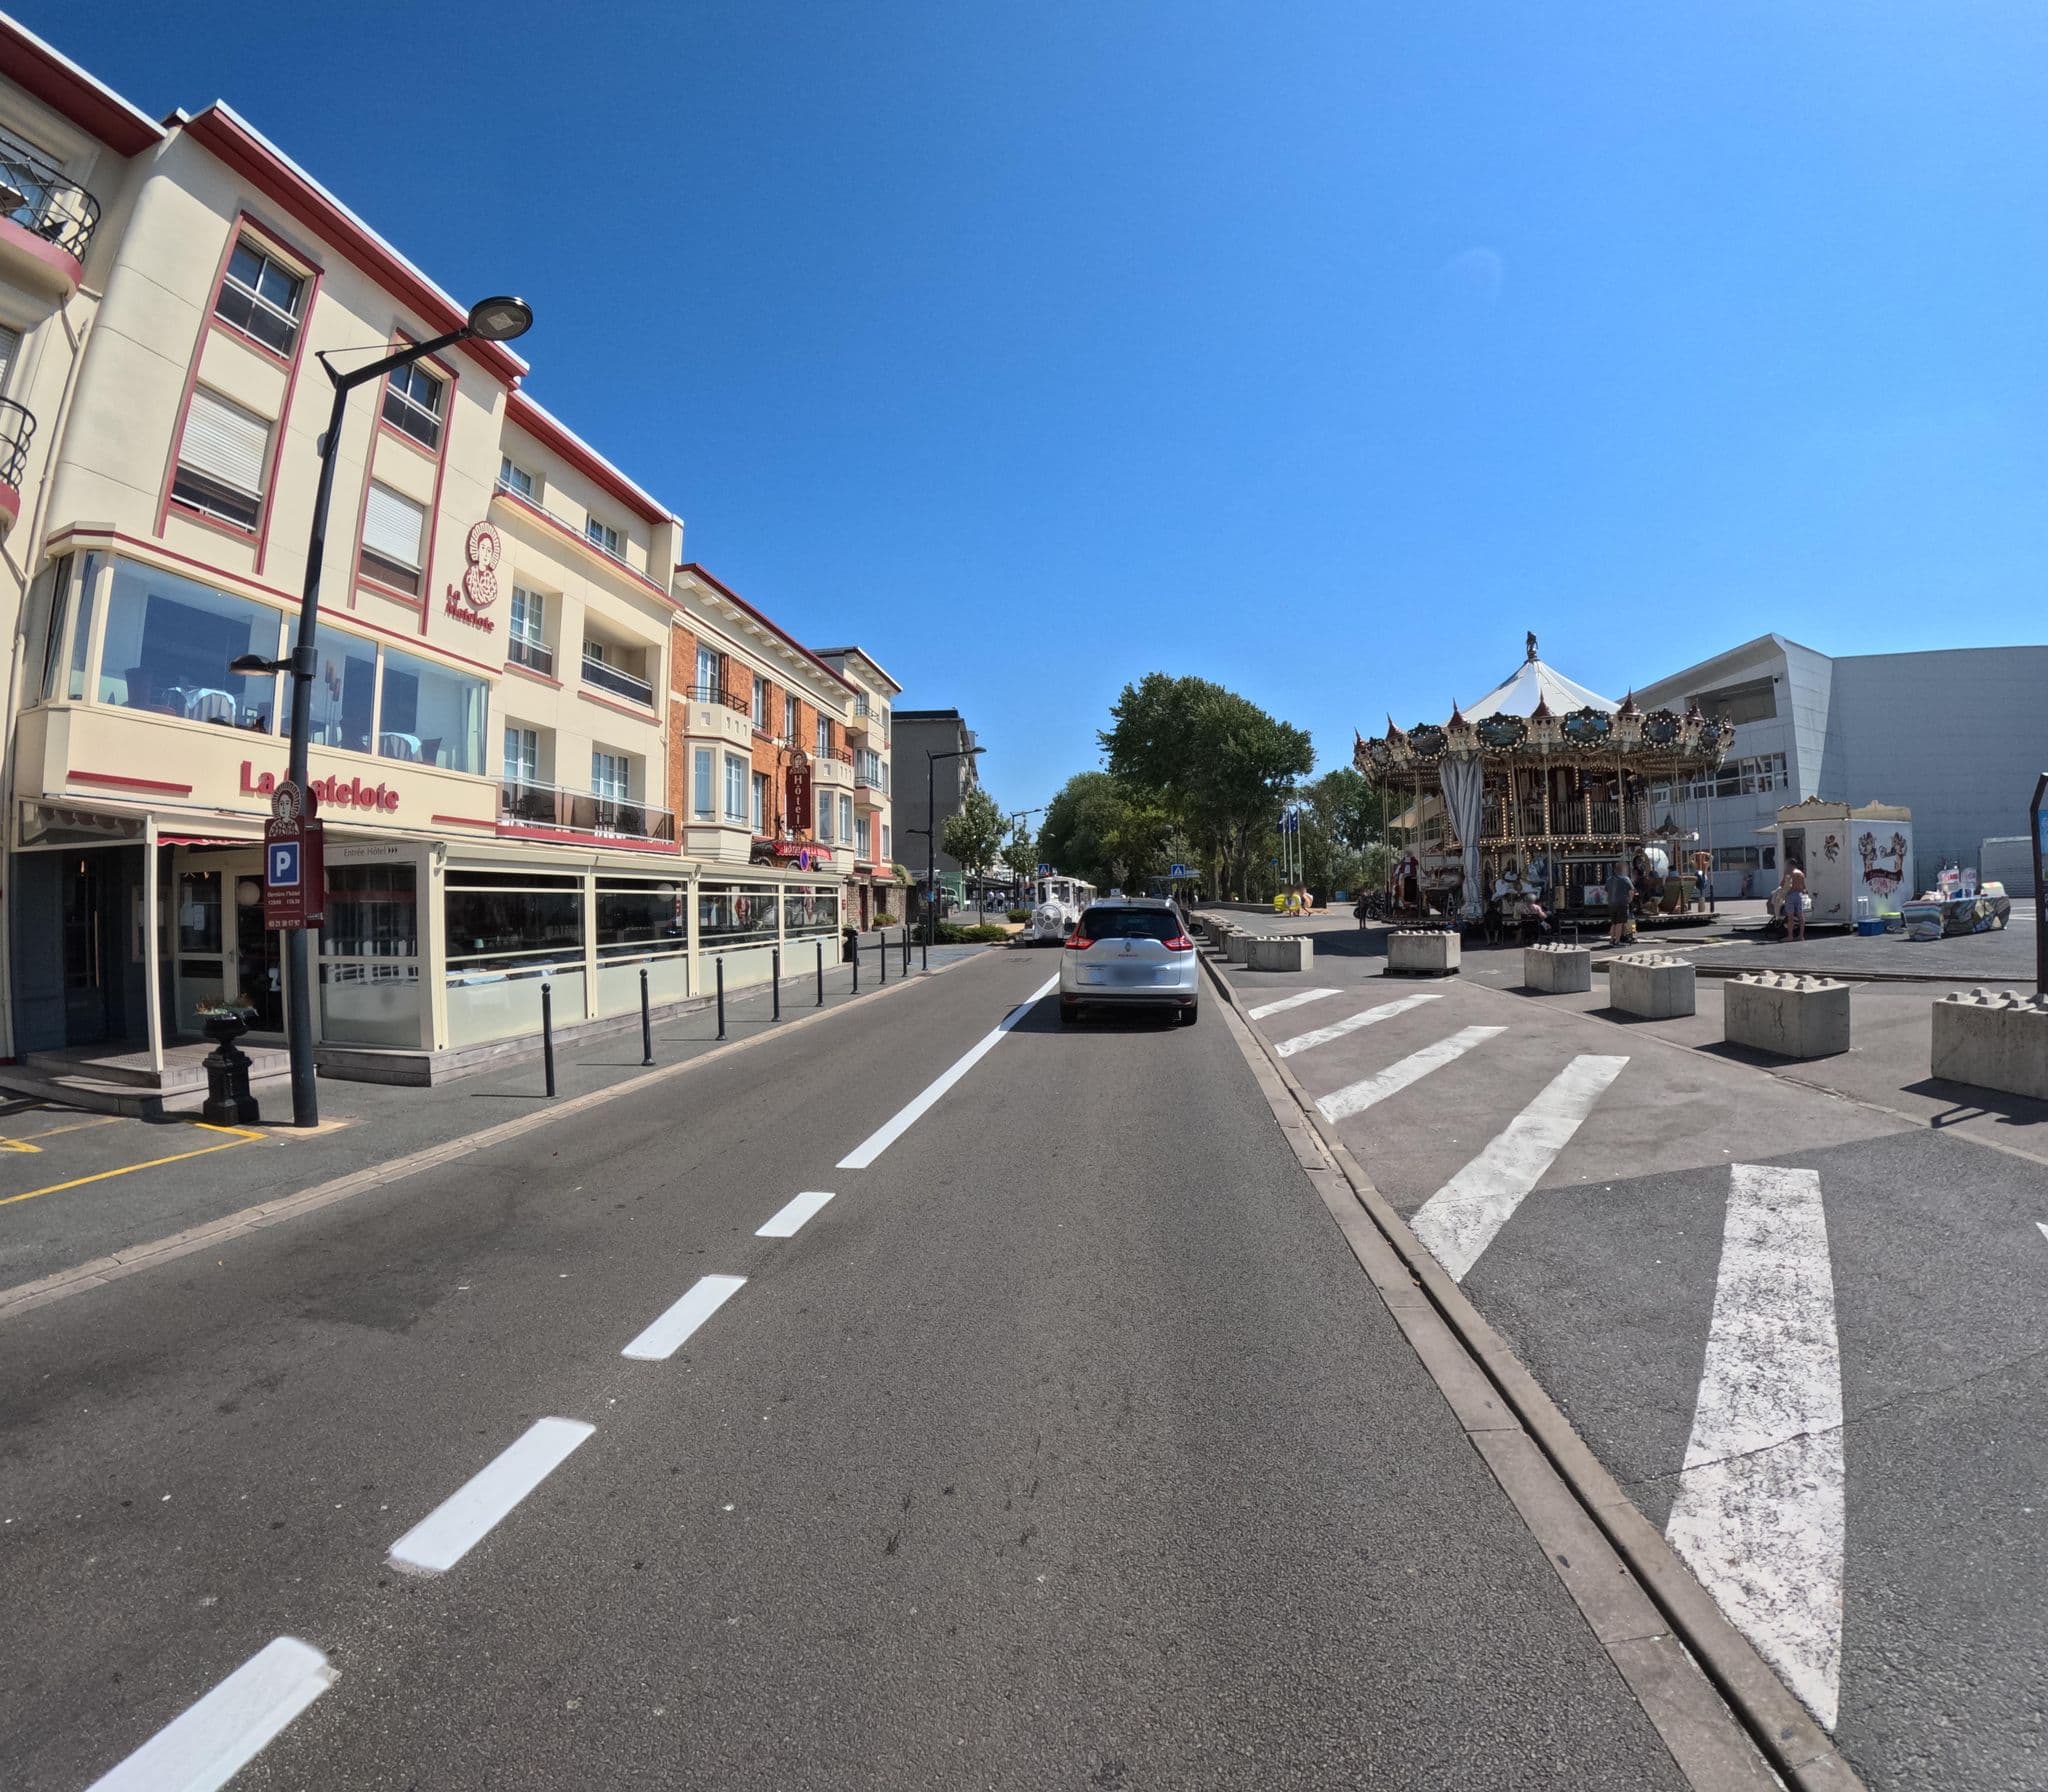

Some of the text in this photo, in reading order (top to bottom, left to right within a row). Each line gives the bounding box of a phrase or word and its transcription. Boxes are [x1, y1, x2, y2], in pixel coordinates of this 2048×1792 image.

[447, 584, 461, 602] La
[445, 602, 495, 632] Matelote
[240, 760, 399, 810] La atelote
[794, 775, 802, 825] Hôtel
[276, 851, 291, 877] P
[343, 844, 386, 857] Entrée Hôtel
